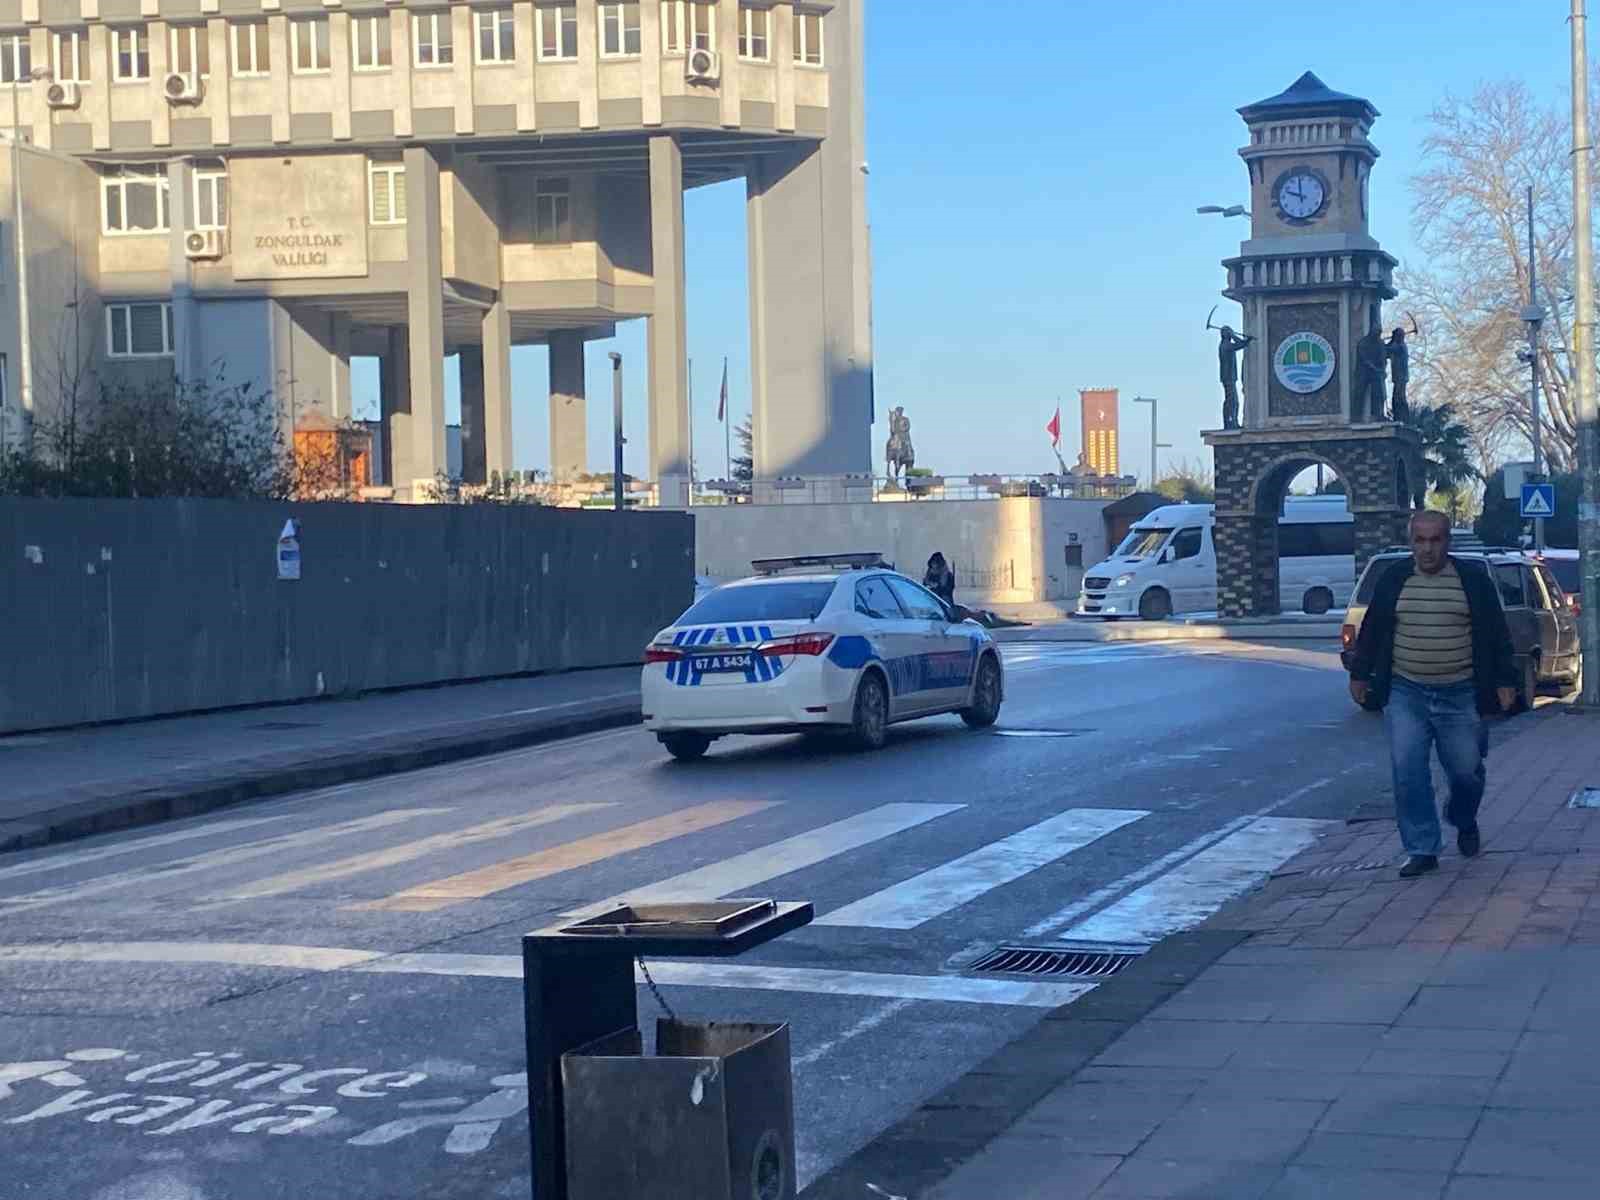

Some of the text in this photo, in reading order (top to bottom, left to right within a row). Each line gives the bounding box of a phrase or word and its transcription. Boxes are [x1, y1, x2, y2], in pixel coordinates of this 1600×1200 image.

[255, 234, 343, 248] ZONGULDAK
[695, 658, 708, 670] 67
[712, 657, 721, 669] A
